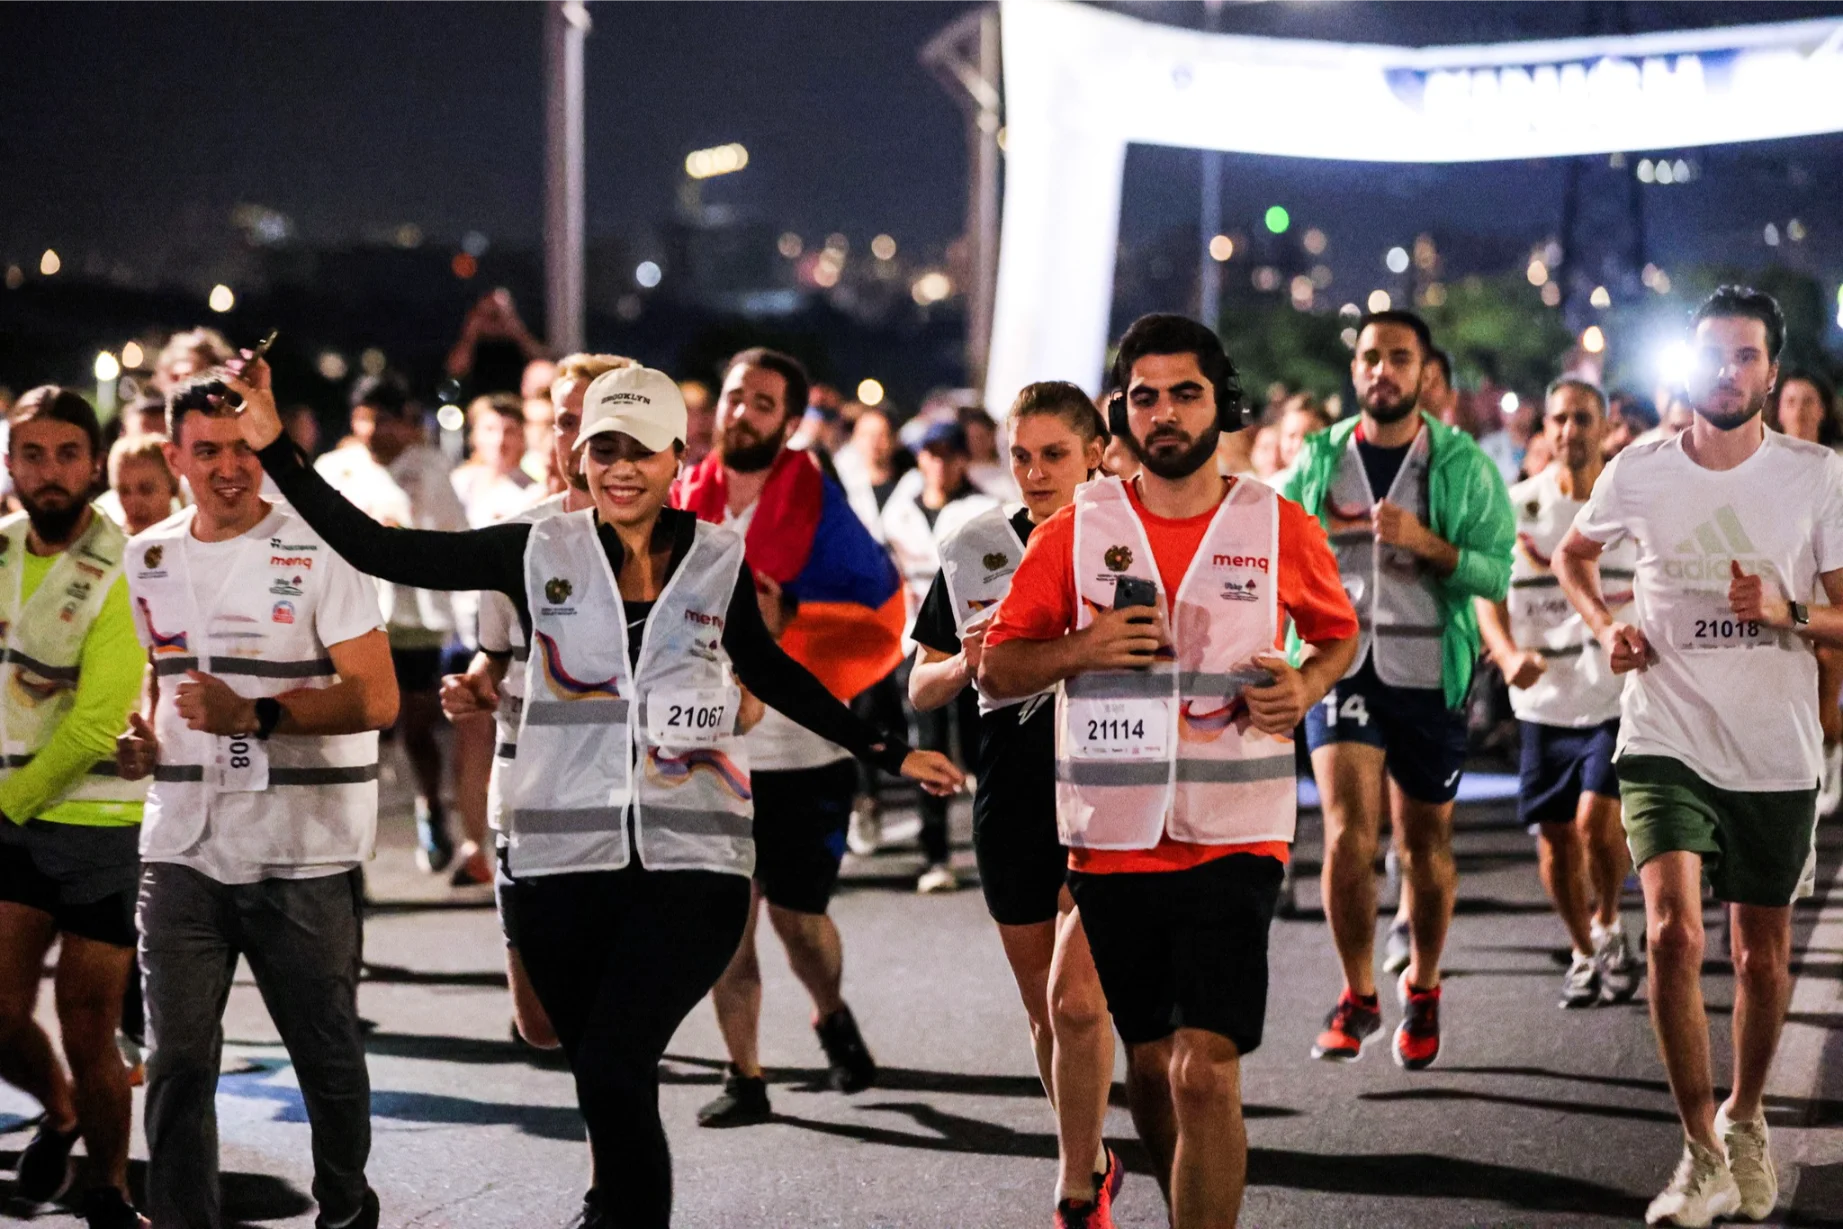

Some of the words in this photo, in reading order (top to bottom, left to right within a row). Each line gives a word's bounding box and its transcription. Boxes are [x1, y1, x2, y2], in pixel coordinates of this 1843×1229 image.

[601, 393, 651, 404] BROOKLYN
[270, 556, 313, 570] menq
[1213, 554, 1268, 574] menq
[1694, 620, 1759, 637] 21018
[667, 705, 724, 728] 21067
[1321, 689, 1369, 727] 14
[1088, 719, 1144, 740] 21114
